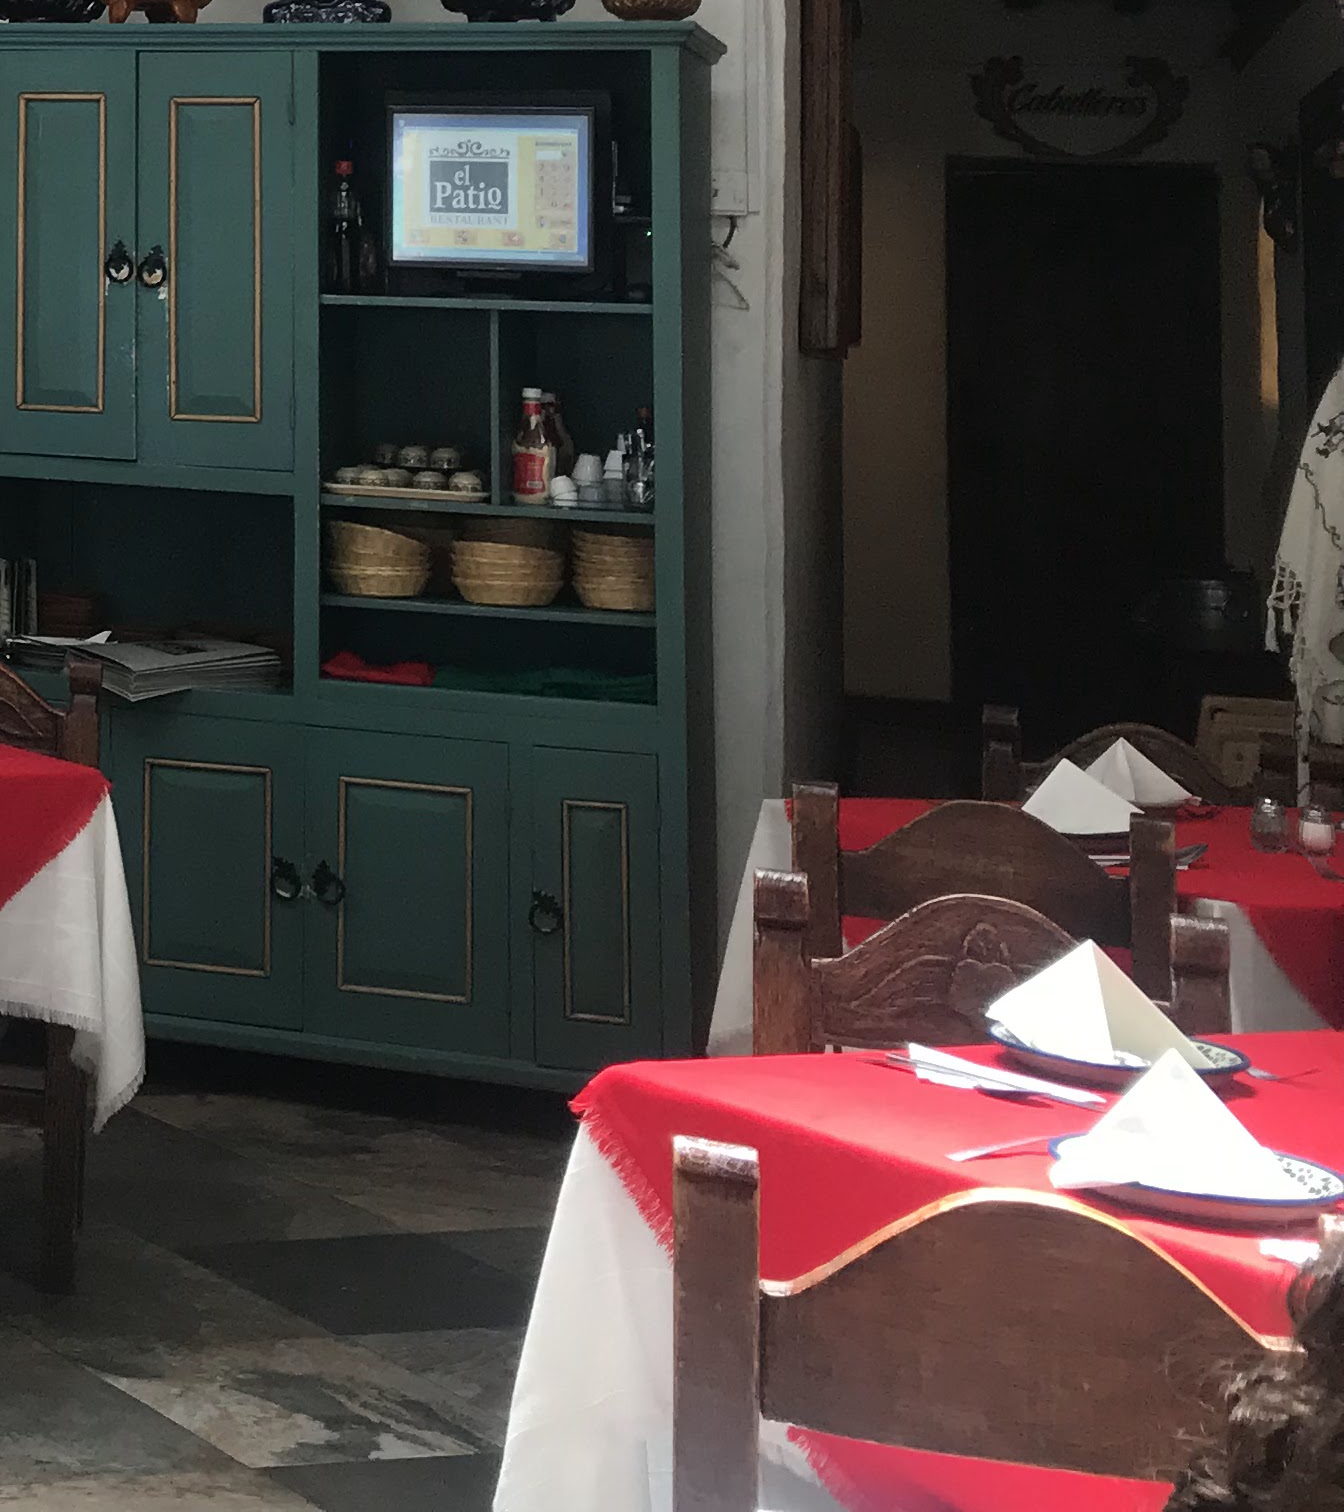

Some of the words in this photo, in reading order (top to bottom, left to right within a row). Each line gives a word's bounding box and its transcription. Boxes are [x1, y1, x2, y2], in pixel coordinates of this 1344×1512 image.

[1008, 83, 1149, 116] Caballeros
[454, 165, 470, 185] el
[434, 182, 502, 210] Patio
